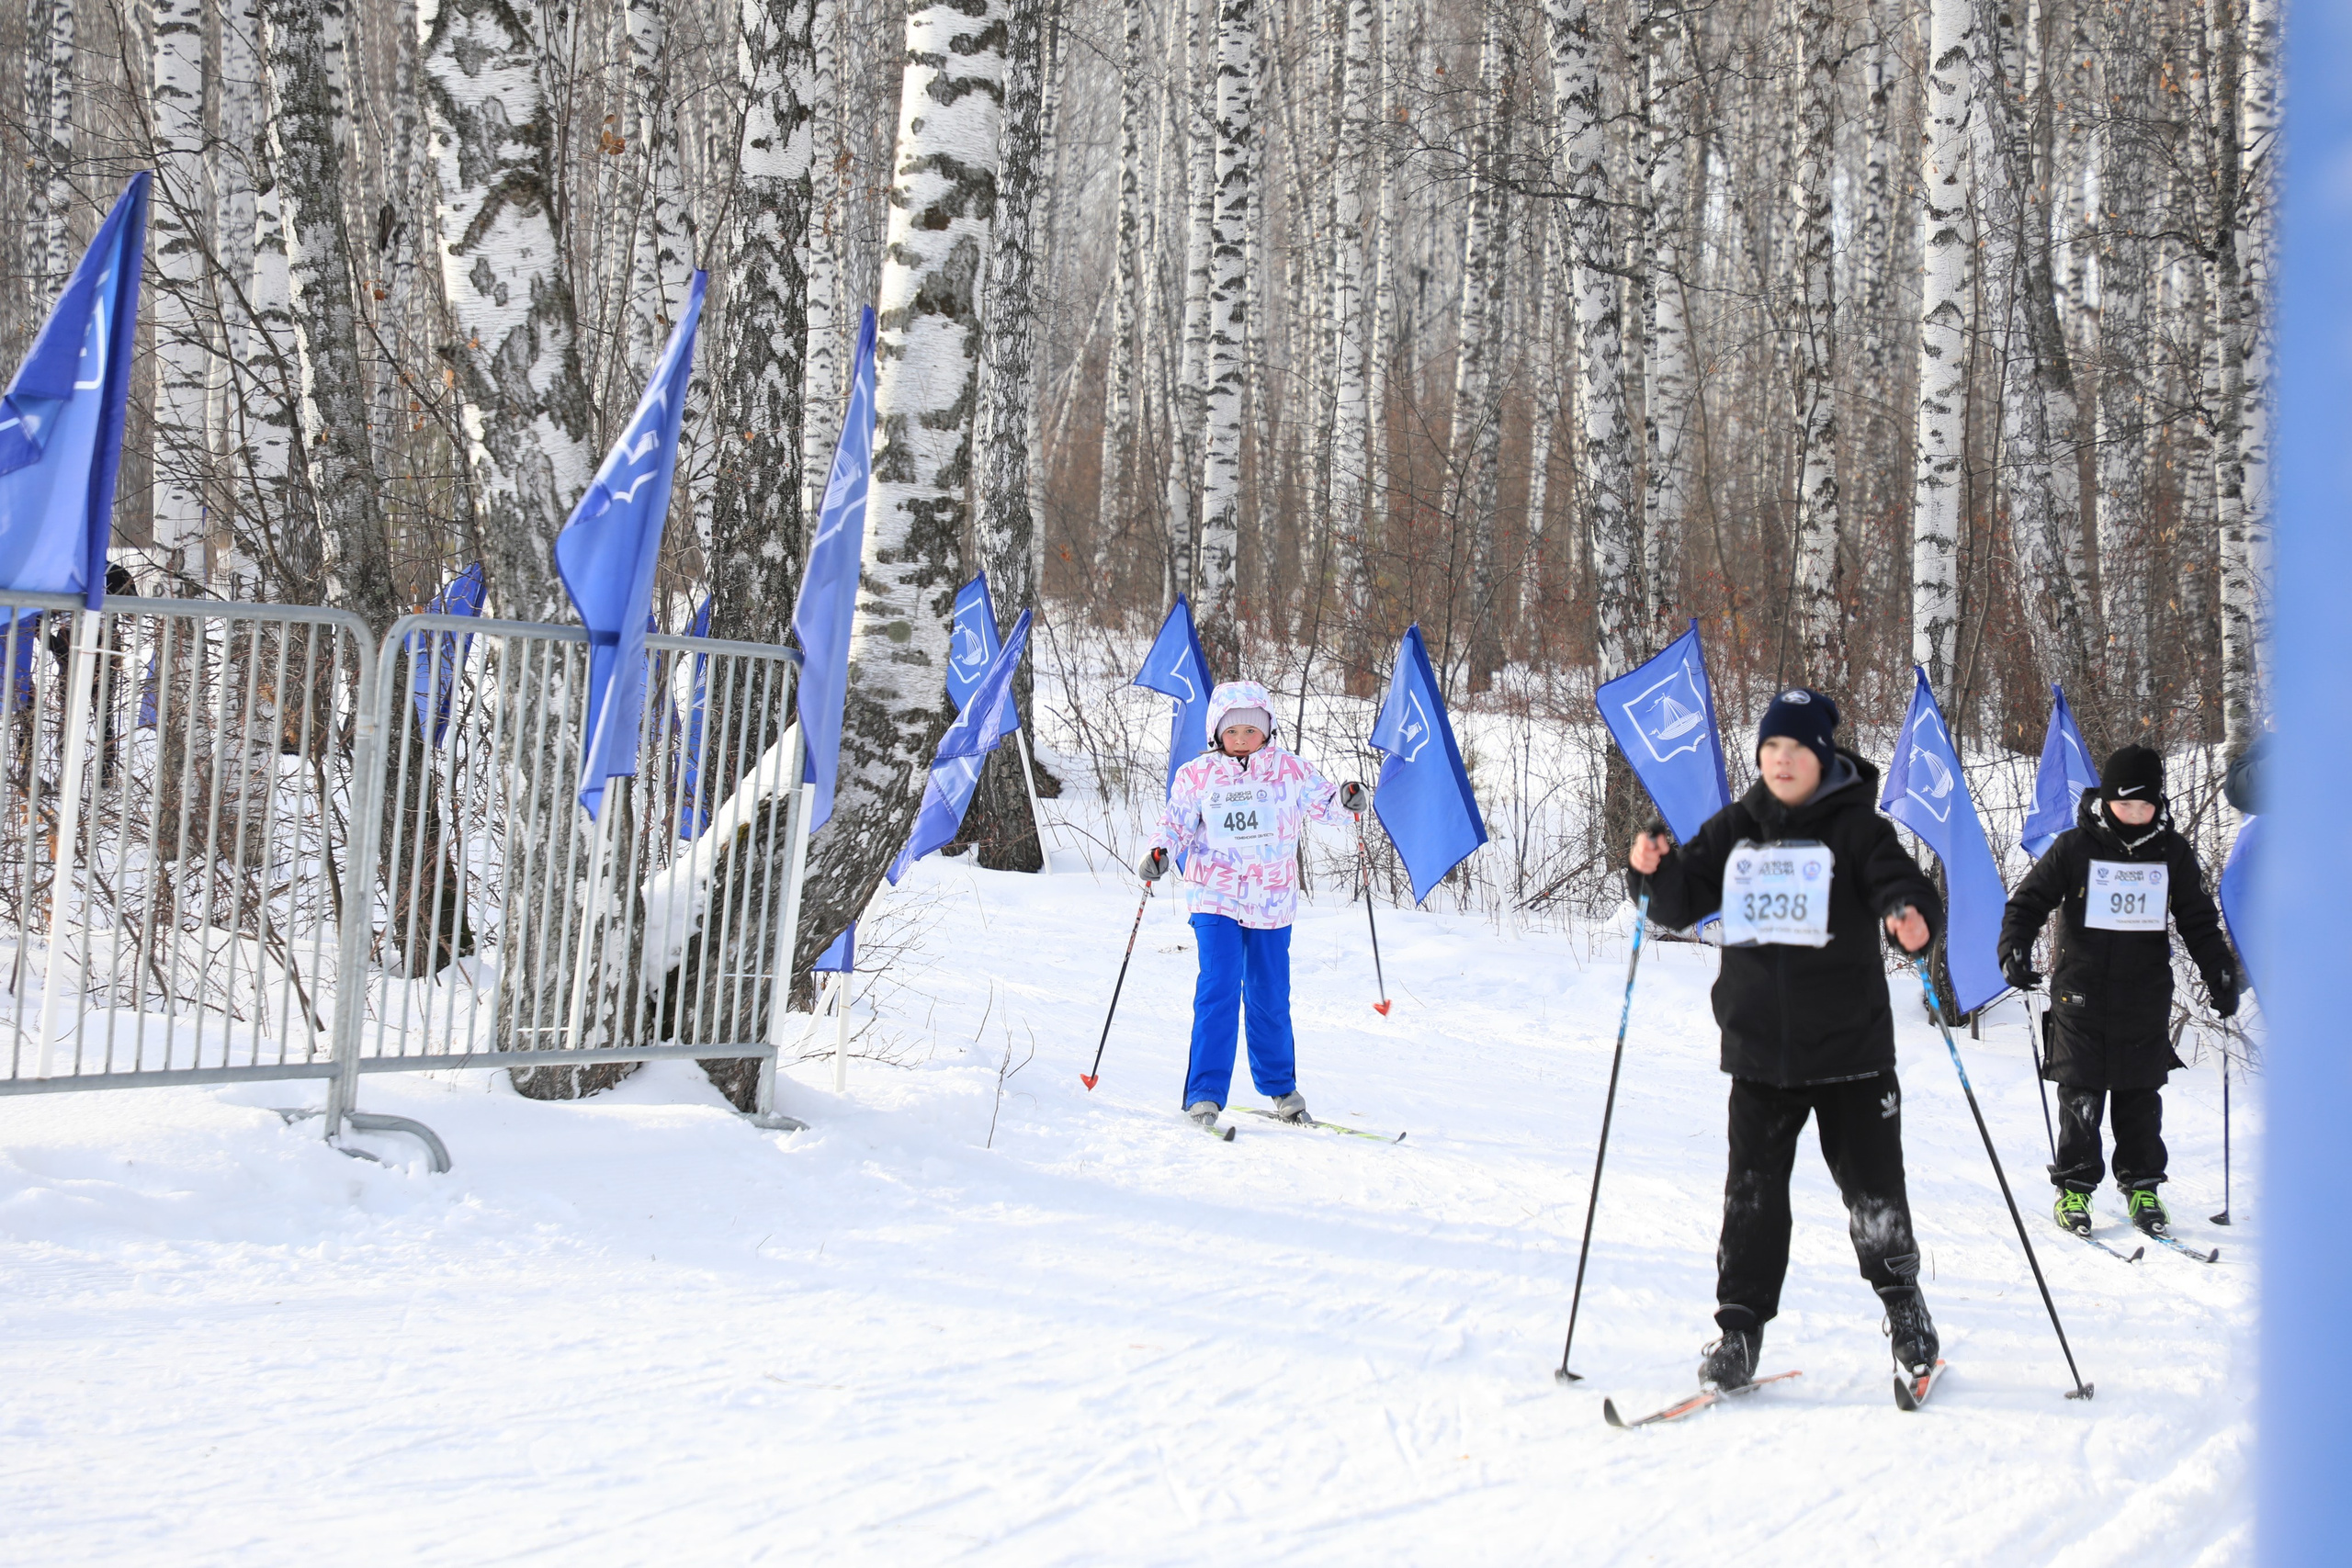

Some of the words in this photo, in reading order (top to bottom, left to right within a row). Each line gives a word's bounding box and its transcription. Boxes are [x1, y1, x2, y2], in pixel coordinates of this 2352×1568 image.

[1223, 810, 1259, 831] 484
[1744, 893, 1808, 921] 3238
[2110, 892, 2146, 914] 981
